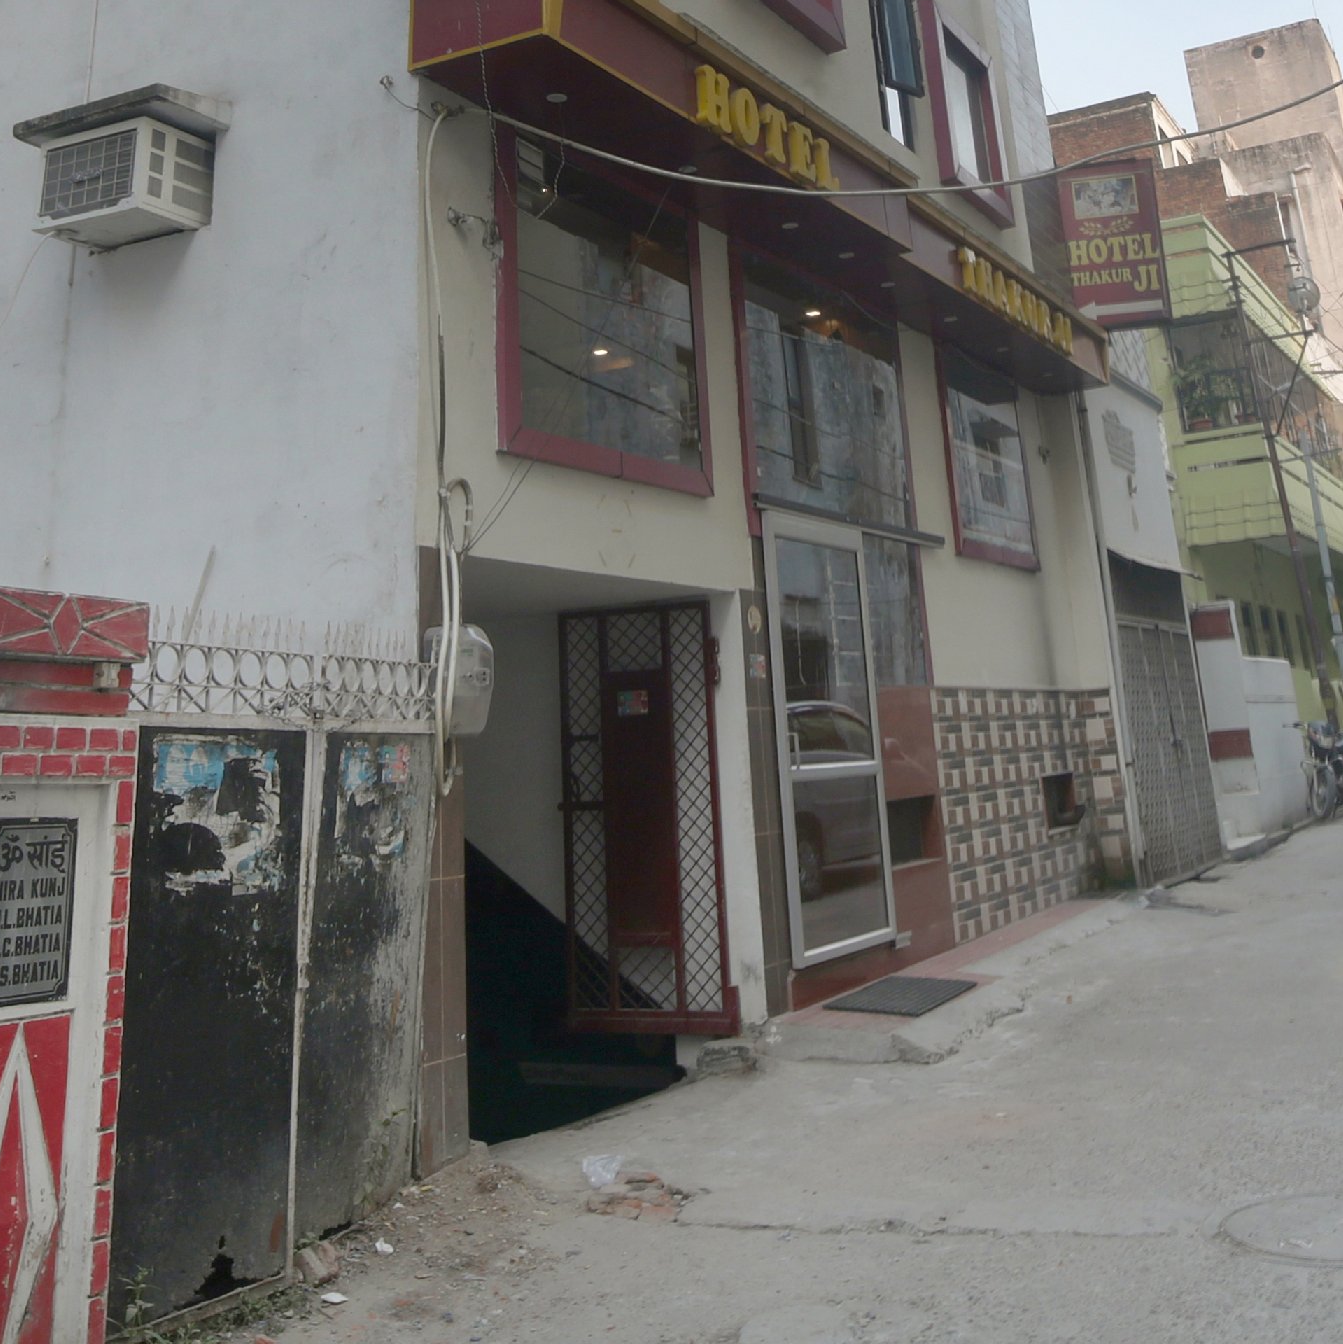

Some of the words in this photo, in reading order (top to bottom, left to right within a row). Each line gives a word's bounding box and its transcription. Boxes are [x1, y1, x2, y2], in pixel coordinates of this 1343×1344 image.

[695, 63, 841, 193] HOTEL
[1068, 233, 1160, 266] HOTEL
[1071, 268, 1133, 287] THAKUR
[1134, 264, 1160, 292] JI
[31, 876, 65, 899] KUNJ
